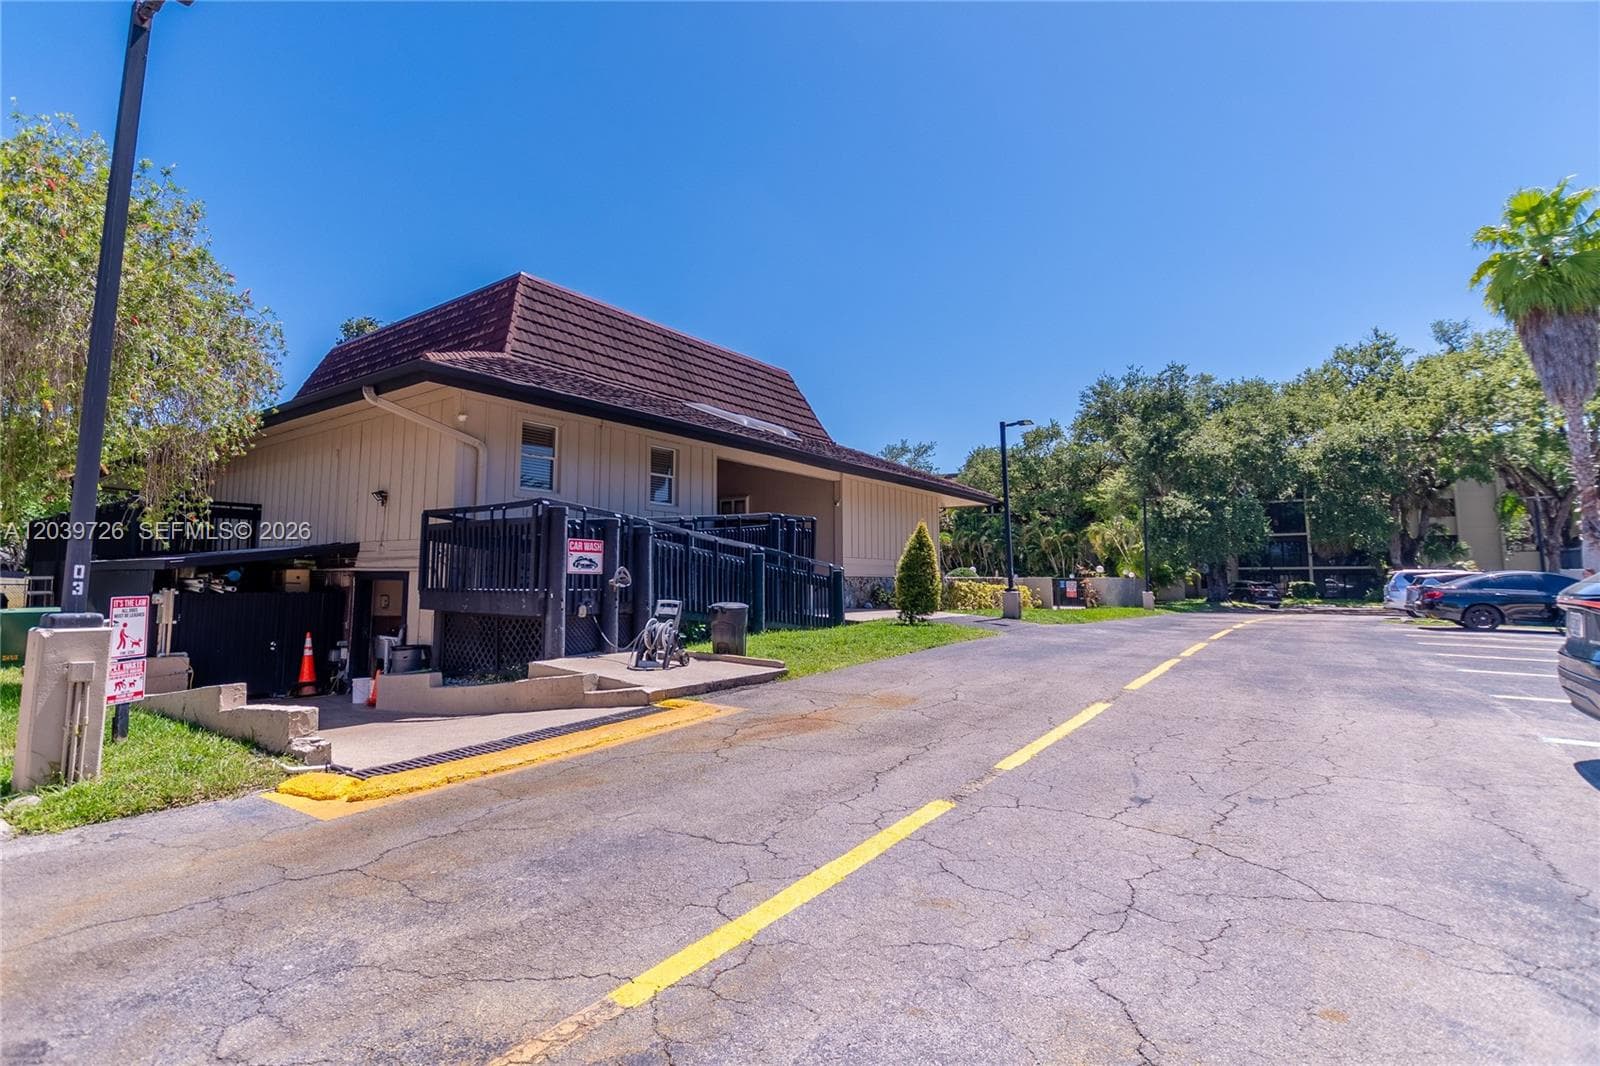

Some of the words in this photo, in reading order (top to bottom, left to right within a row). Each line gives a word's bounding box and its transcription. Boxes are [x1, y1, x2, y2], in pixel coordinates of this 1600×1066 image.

[569, 541, 583, 551] CAR
[583, 541, 602, 552] WASH
[113, 599, 123, 607] IT'S
[124, 599, 135, 607] THE
[135, 598, 147, 607] LAW
